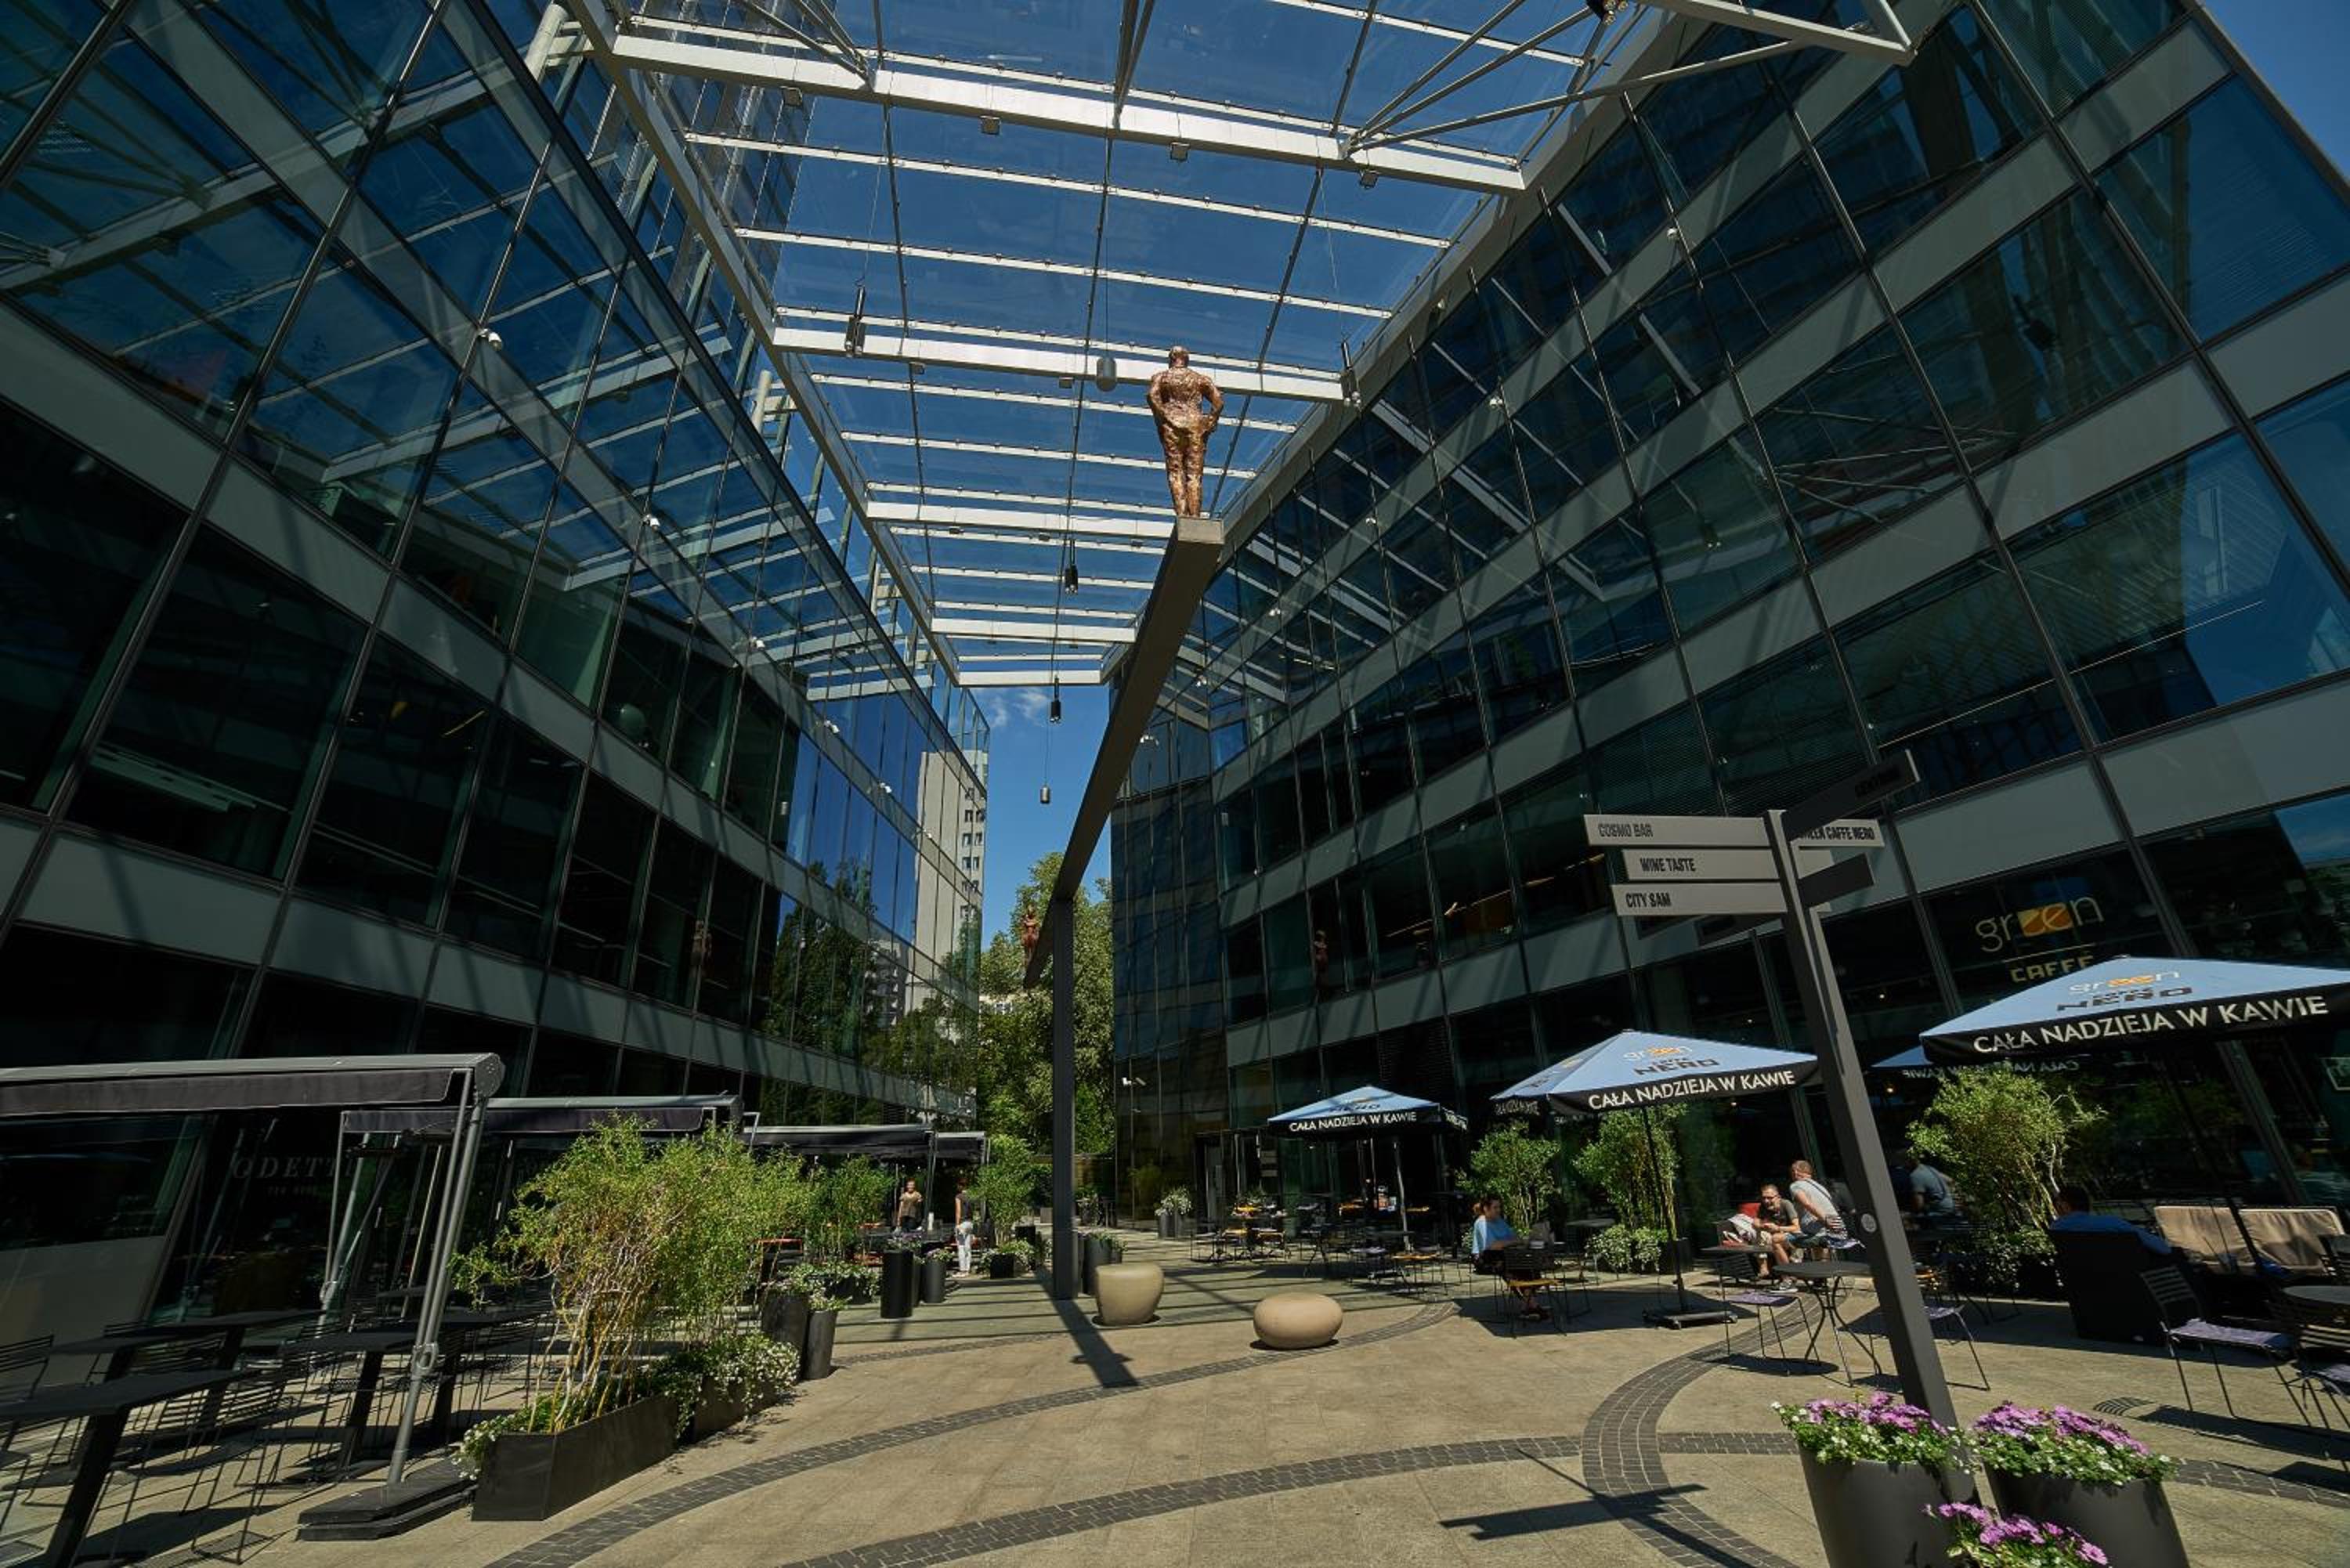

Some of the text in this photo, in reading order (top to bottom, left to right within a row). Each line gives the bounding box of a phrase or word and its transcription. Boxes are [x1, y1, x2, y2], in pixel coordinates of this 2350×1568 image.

[1597, 822, 1654, 837] COSMO BAR
[1826, 826, 1851, 840] CAFFE
[1852, 826, 1875, 840] NERO
[1640, 858, 1696, 873] WINE TASTE
[1625, 892, 1672, 909] CITY SAM
[1975, 896, 2105, 952] green
[1972, 995, 2330, 1054] CAŁA NADZIEJA W KAWIE
[1588, 1071, 1796, 1111] CAŁA NADZIEJA W KAWIE
[1289, 1111, 1418, 1133] CAŁA NADZIEJA W KAWIE
